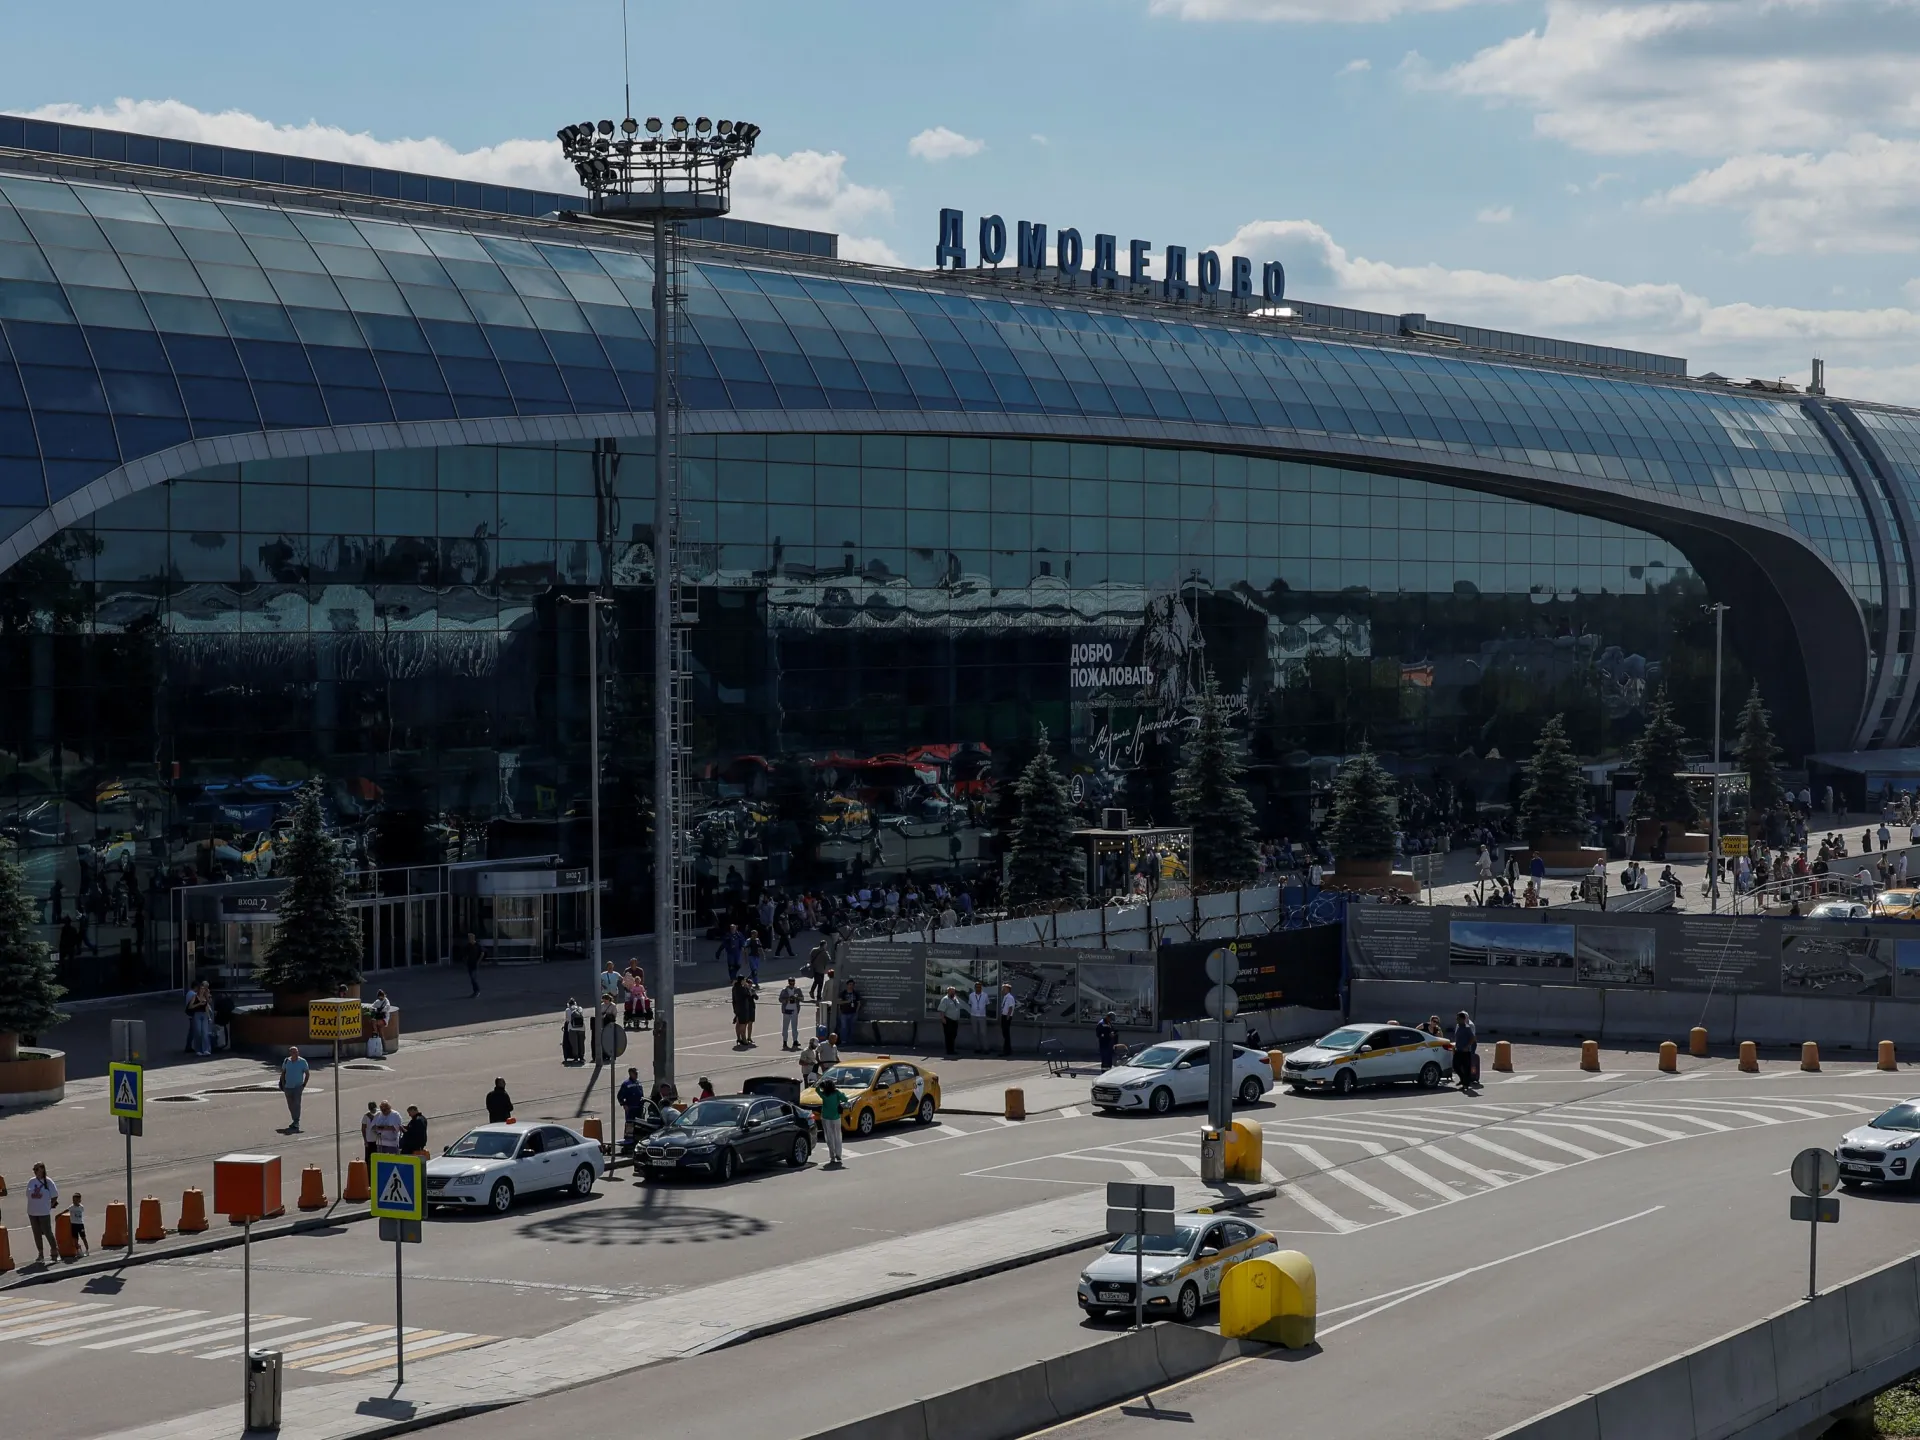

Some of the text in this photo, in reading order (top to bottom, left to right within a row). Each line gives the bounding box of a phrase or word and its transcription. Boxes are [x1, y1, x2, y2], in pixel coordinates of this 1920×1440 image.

[936, 208, 1285, 302] ДОМОДЕДОВО
[1070, 643, 1113, 666] ДОБРО
[1070, 666, 1154, 688] ПОЖАЛОВАТЬ
[238, 898, 258, 907] ВХОД
[260, 898, 268, 911] 2
[311, 1015, 337, 1026] Taxi
[341, 1012, 360, 1026] Taxi
